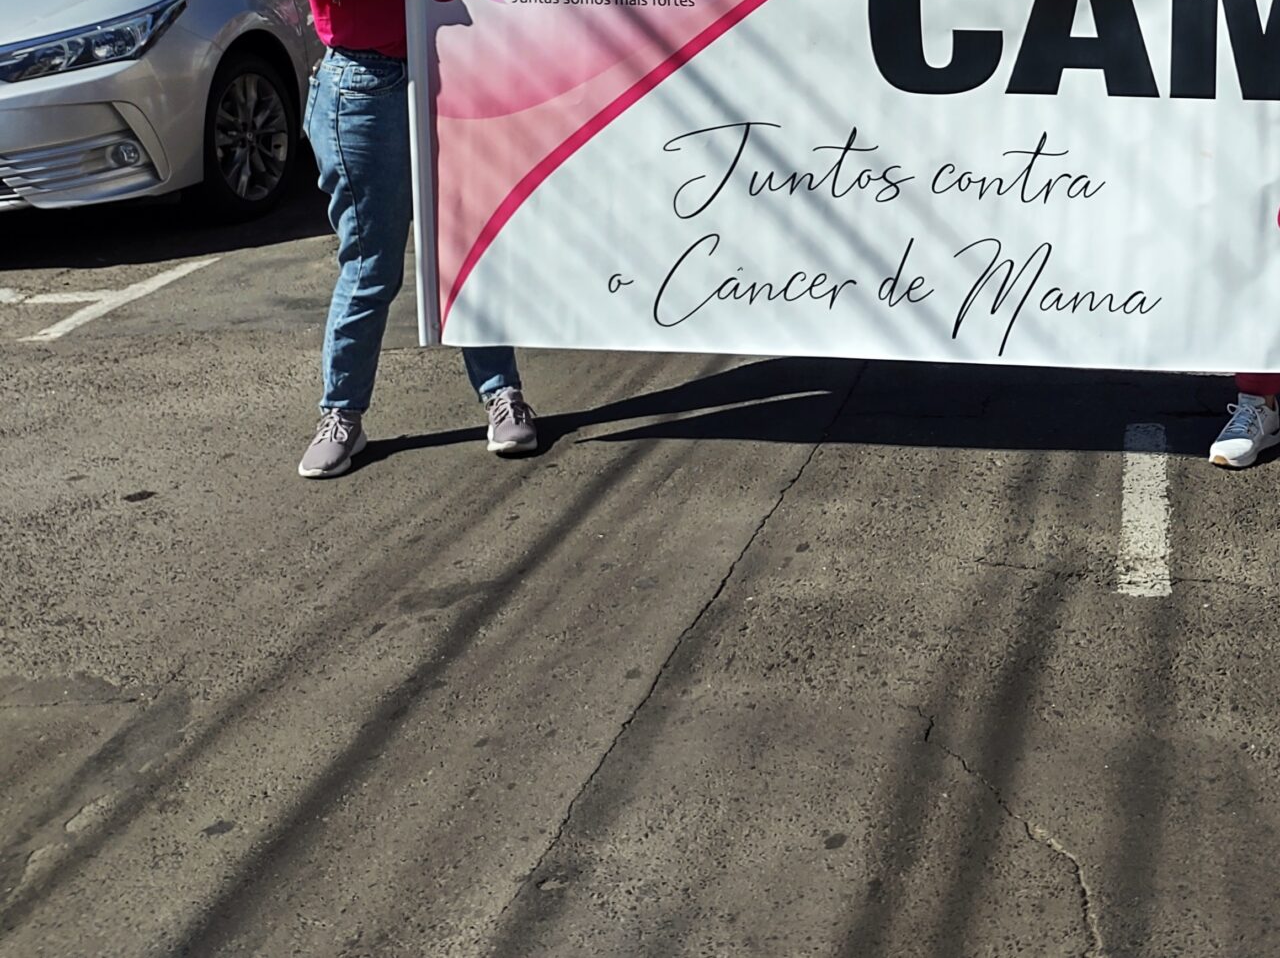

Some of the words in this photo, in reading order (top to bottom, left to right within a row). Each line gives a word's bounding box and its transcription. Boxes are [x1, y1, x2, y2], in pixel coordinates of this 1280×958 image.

[663, 121, 915, 219] Juntos
[931, 131, 1107, 204] contra
[608, 271, 634, 294] o
[653, 233, 858, 326] Câncer
[878, 237, 935, 308] de
[952, 238, 1163, 357] Mama
